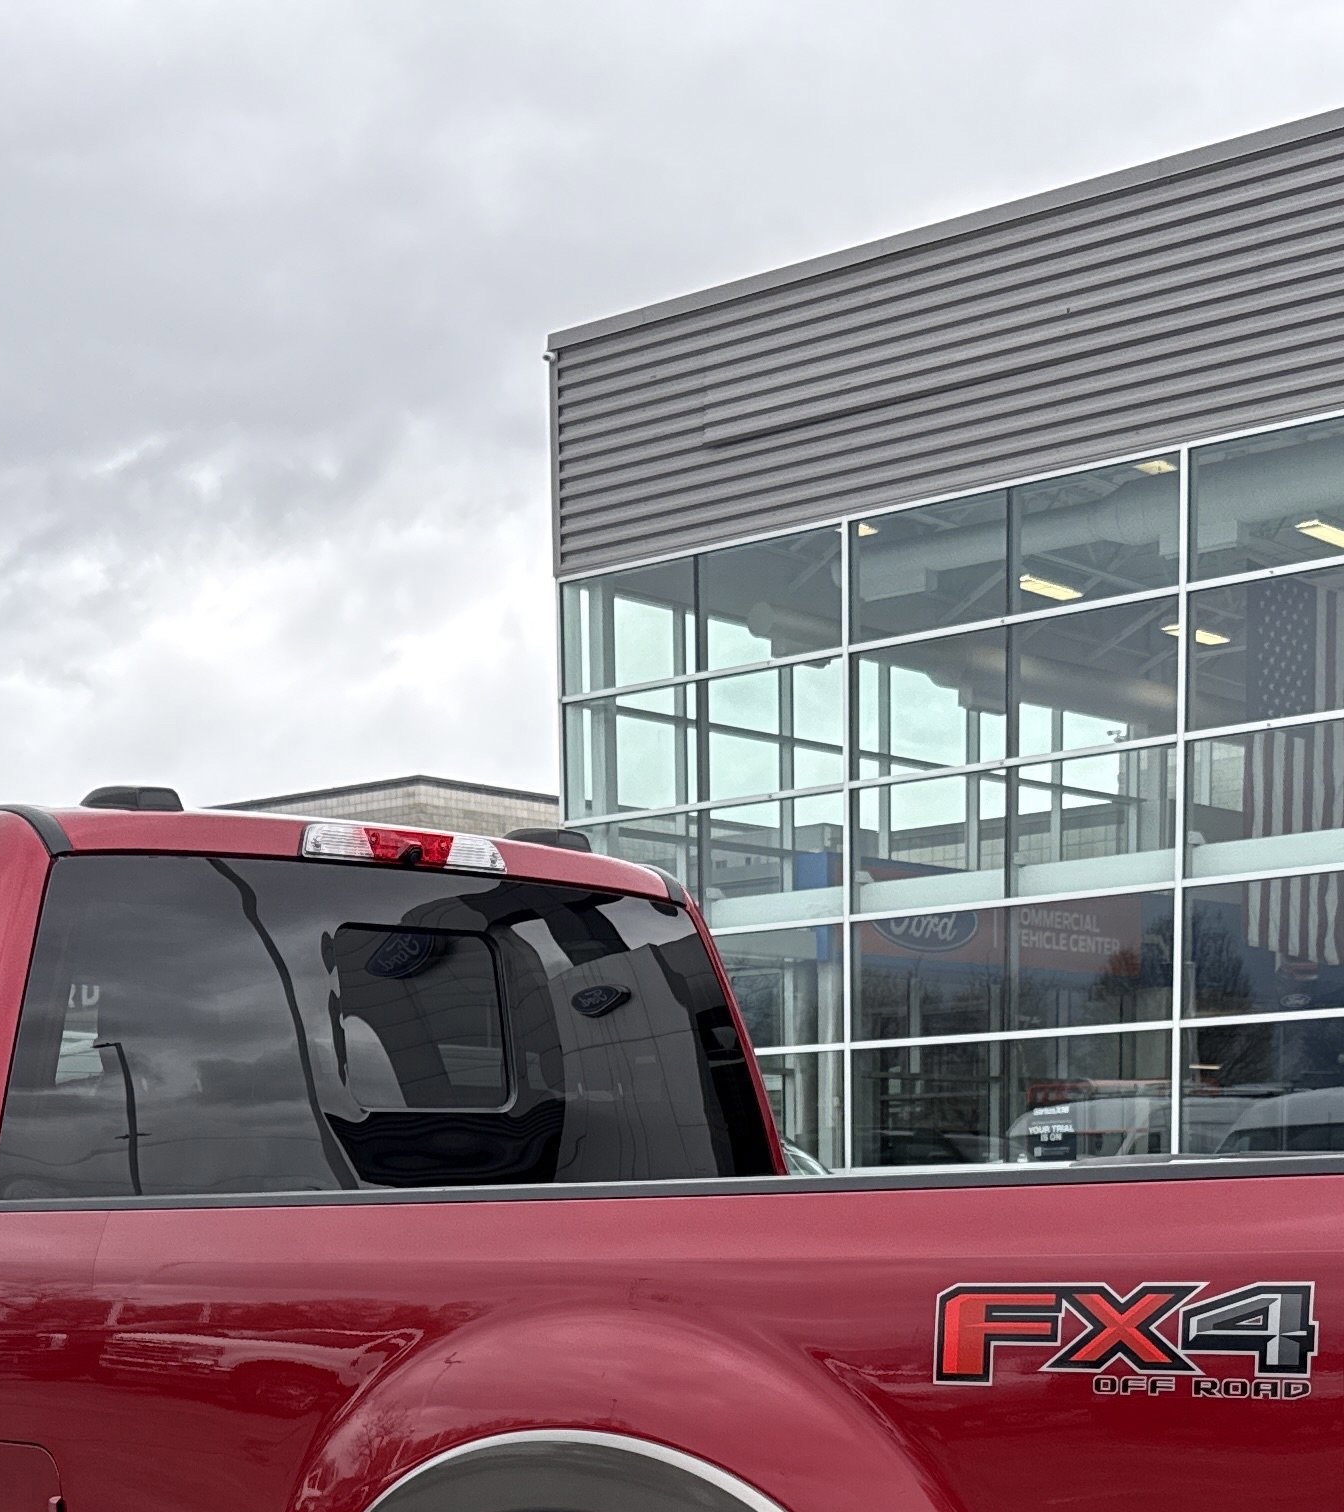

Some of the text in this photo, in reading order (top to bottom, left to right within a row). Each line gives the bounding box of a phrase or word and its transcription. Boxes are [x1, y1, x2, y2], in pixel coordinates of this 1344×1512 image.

[1017, 908, 1100, 933] OMMERCIAL
[1068, 933, 1121, 955] CENTER
[933, 1281, 1319, 1387] FX4
[1092, 1376, 1312, 1400] OFF ROAD
